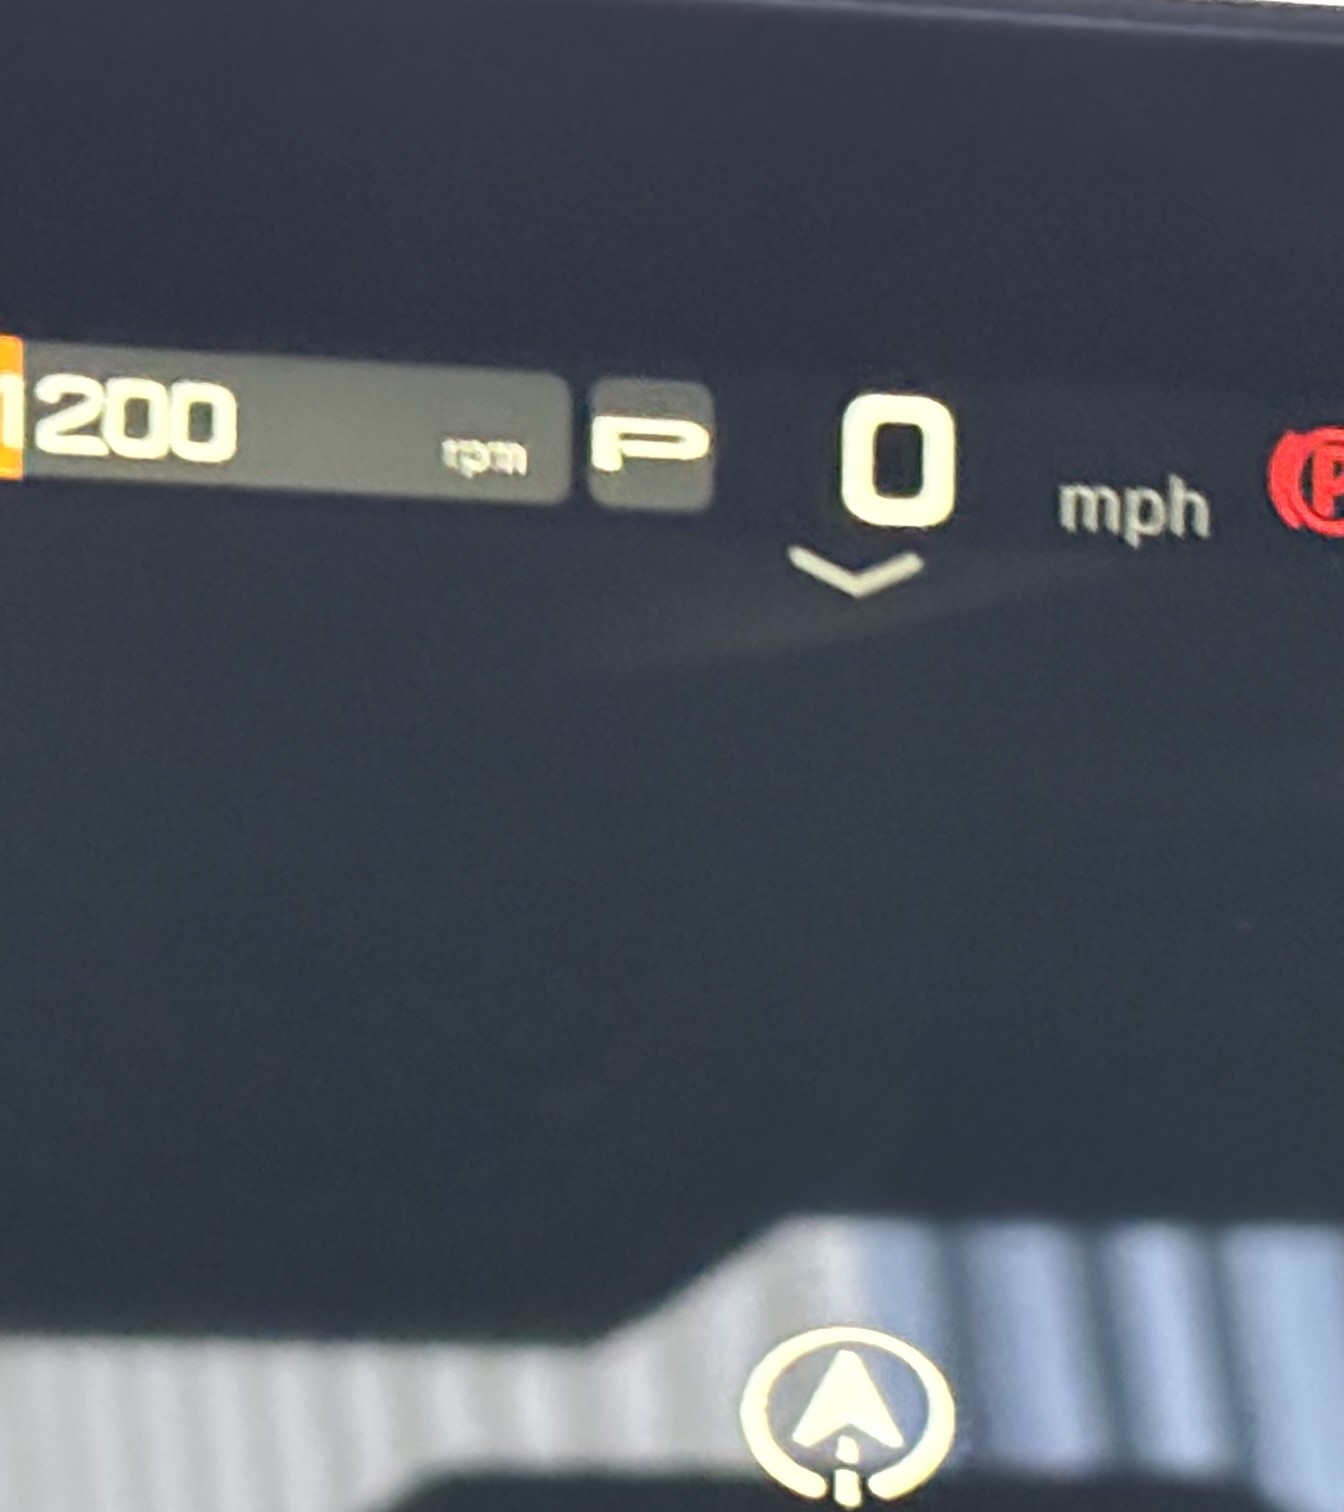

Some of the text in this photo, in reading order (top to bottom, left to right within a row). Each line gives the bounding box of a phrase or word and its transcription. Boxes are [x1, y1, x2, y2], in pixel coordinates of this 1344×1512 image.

[441, 436, 528, 478] rpm
[590, 414, 710, 472] P
[841, 393, 1212, 549] 0 mph
